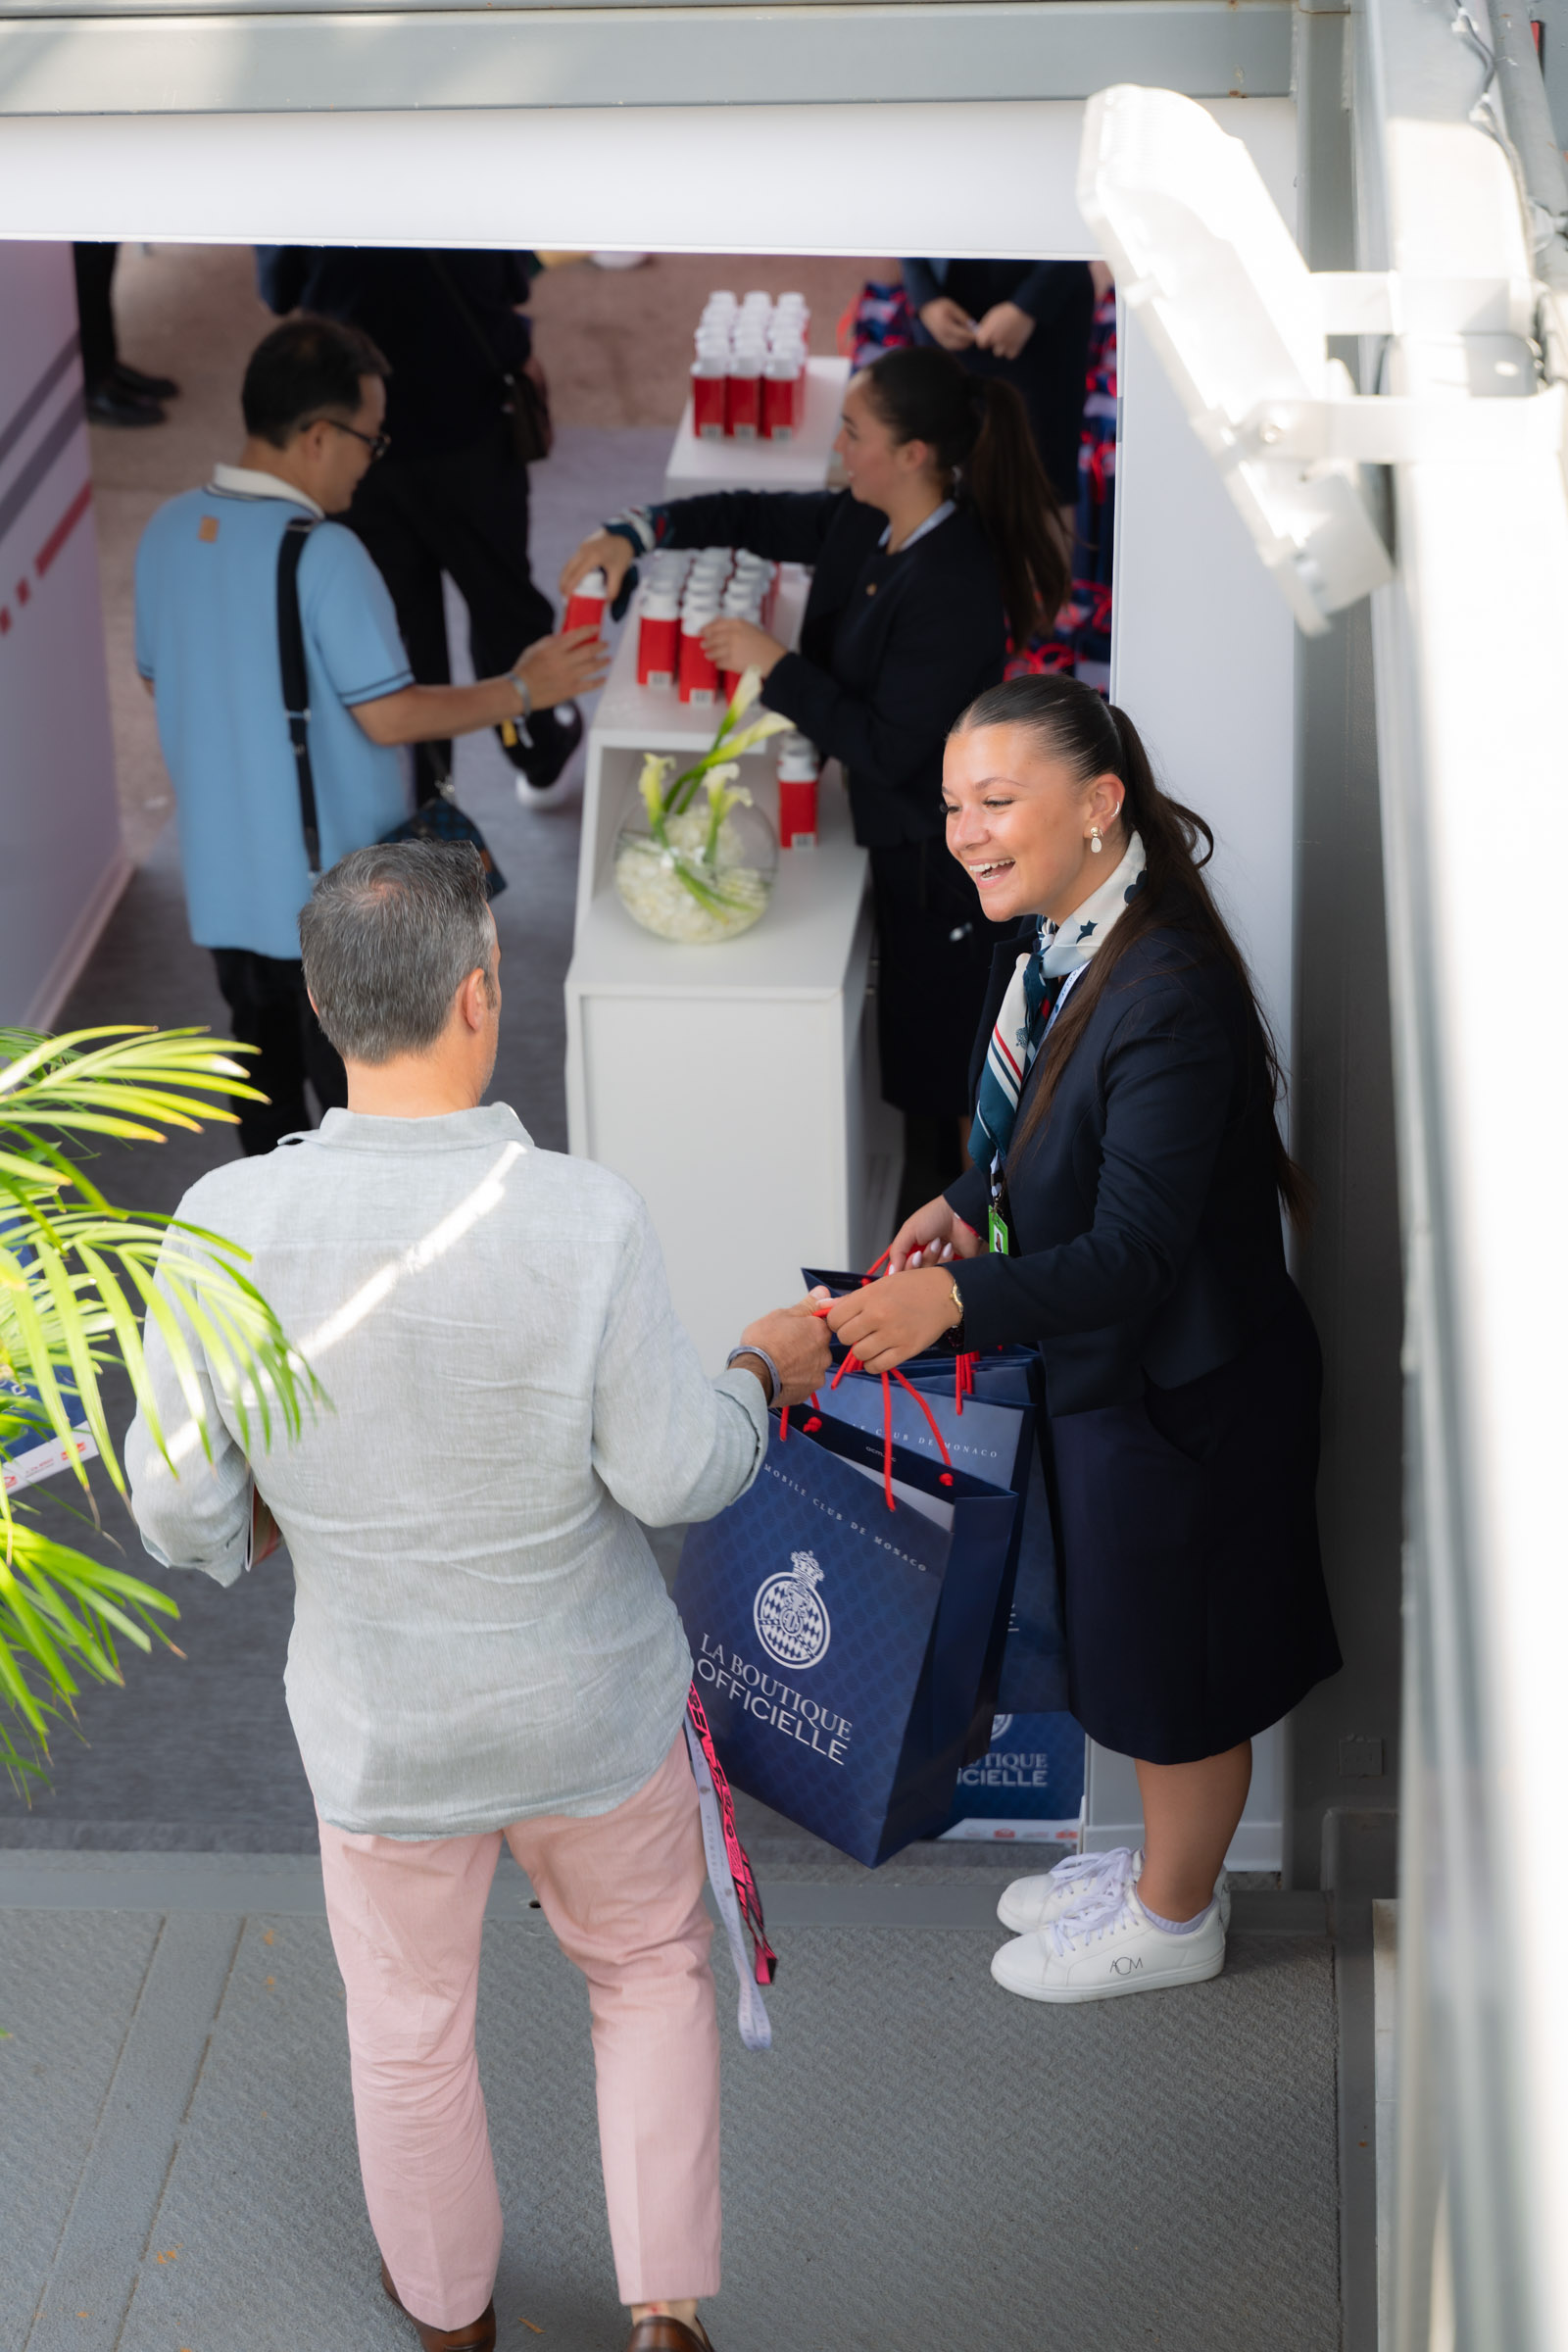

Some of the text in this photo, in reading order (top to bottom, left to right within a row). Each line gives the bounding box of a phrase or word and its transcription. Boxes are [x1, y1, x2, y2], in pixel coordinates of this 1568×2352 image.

[875, 1429, 998, 1458] CUB DE MONACO
[812, 1497, 843, 1521] CLUB
[850, 1522, 867, 1535] DE
[874, 1536, 927, 1572] MONACO
[697, 1658, 848, 1766] OFFICIELLE
[700, 1632, 725, 1666] LA
[730, 1653, 853, 1741] BOUTIQUE
[1109, 1956, 1143, 1975] ACM
